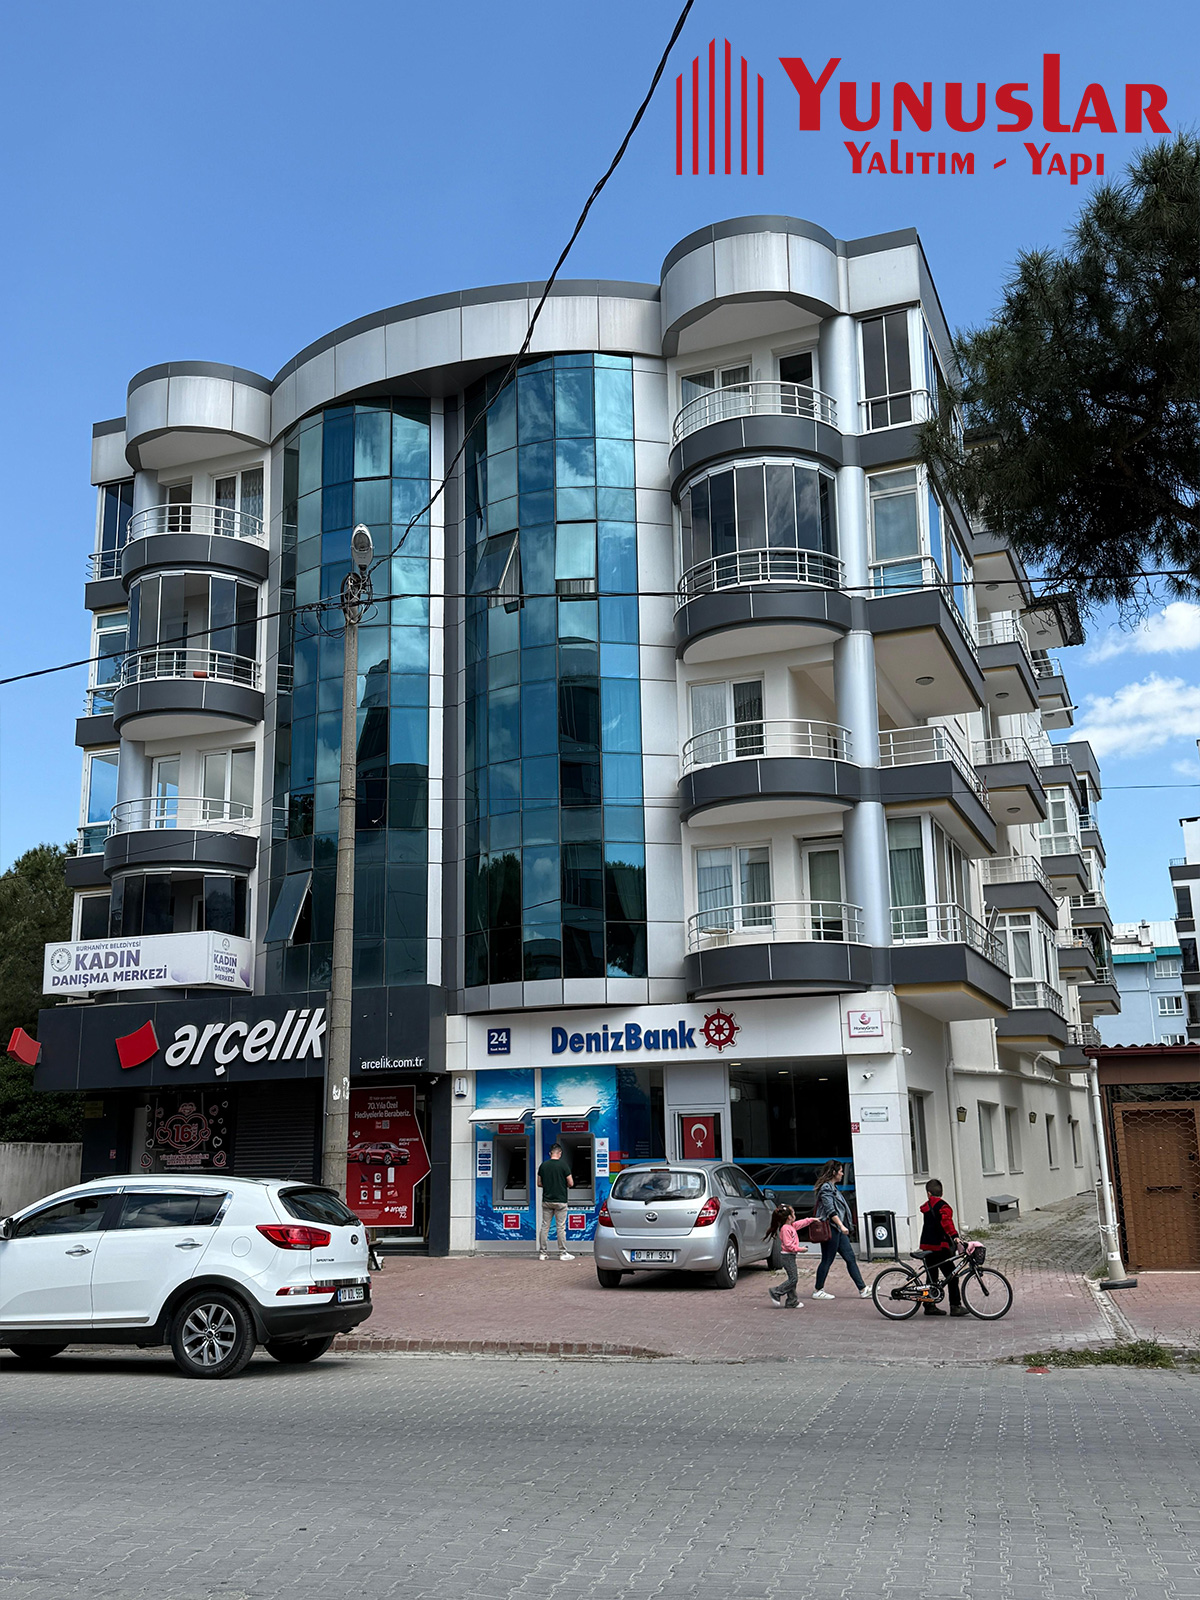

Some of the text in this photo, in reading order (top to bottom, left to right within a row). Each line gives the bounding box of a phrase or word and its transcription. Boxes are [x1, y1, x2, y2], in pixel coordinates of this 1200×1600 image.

[76, 940, 141, 952] BURHANİYE BELEDİYESİ
[75, 949, 141, 972] KADIN
[213, 953, 238, 967] KADIN
[52, 964, 167, 988] DANIŞMA MERKEZİ
[165, 1007, 327, 1076] arçelik
[490, 1032, 508, 1045] 24
[551, 1020, 697, 1054] DenizBank
[360, 1057, 423, 1071] arcelik.com.tr
[635, 1251, 642, 1259] 10
